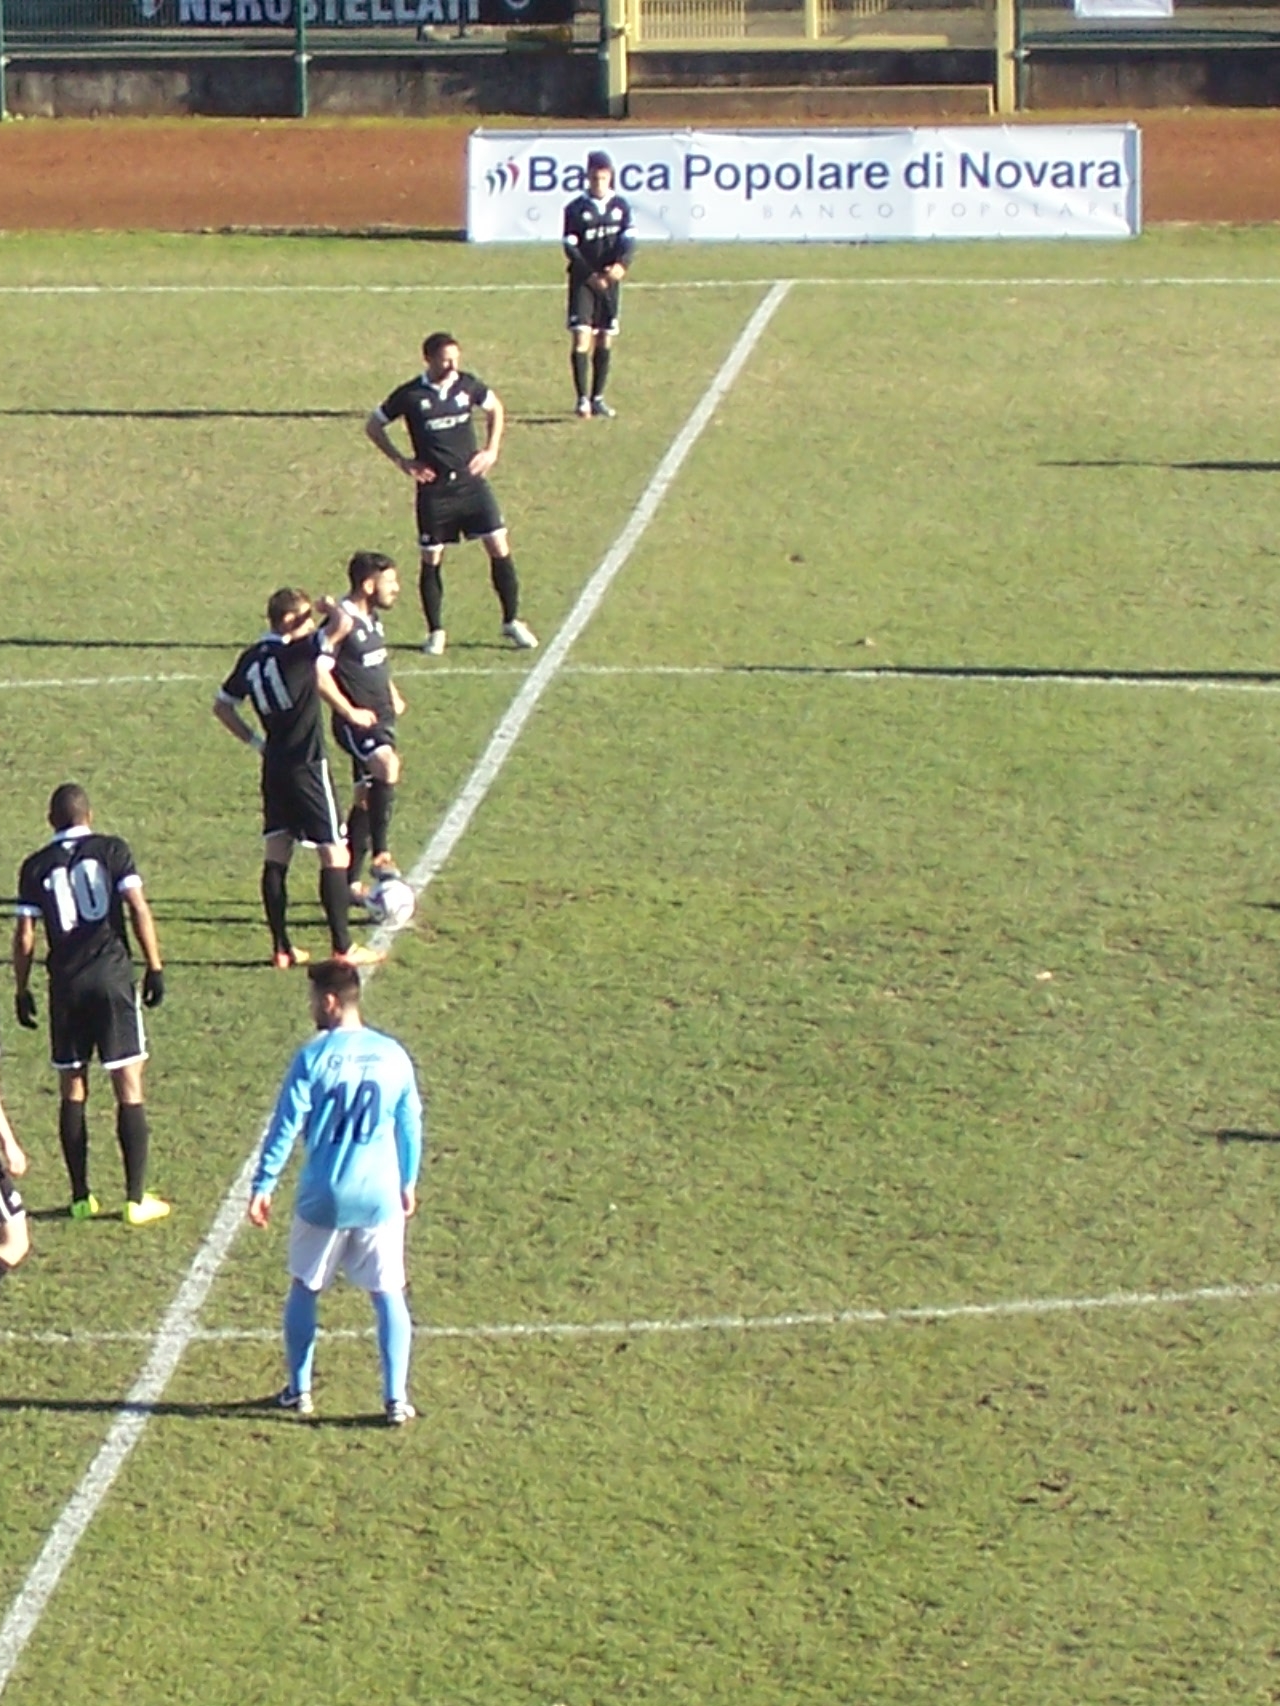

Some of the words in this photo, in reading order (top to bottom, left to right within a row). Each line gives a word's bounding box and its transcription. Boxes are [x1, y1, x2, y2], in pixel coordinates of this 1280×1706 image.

[527, 155, 671, 192] Baca
[683, 152, 890, 200] Popolare
[903, 152, 944, 189] di
[959, 151, 1120, 189] Novara
[527, 204, 707, 222] GPO
[763, 203, 894, 222] BANCO
[927, 202, 1124, 219] POPOLARE
[246, 656, 293, 715] 11
[43, 858, 110, 932] 10
